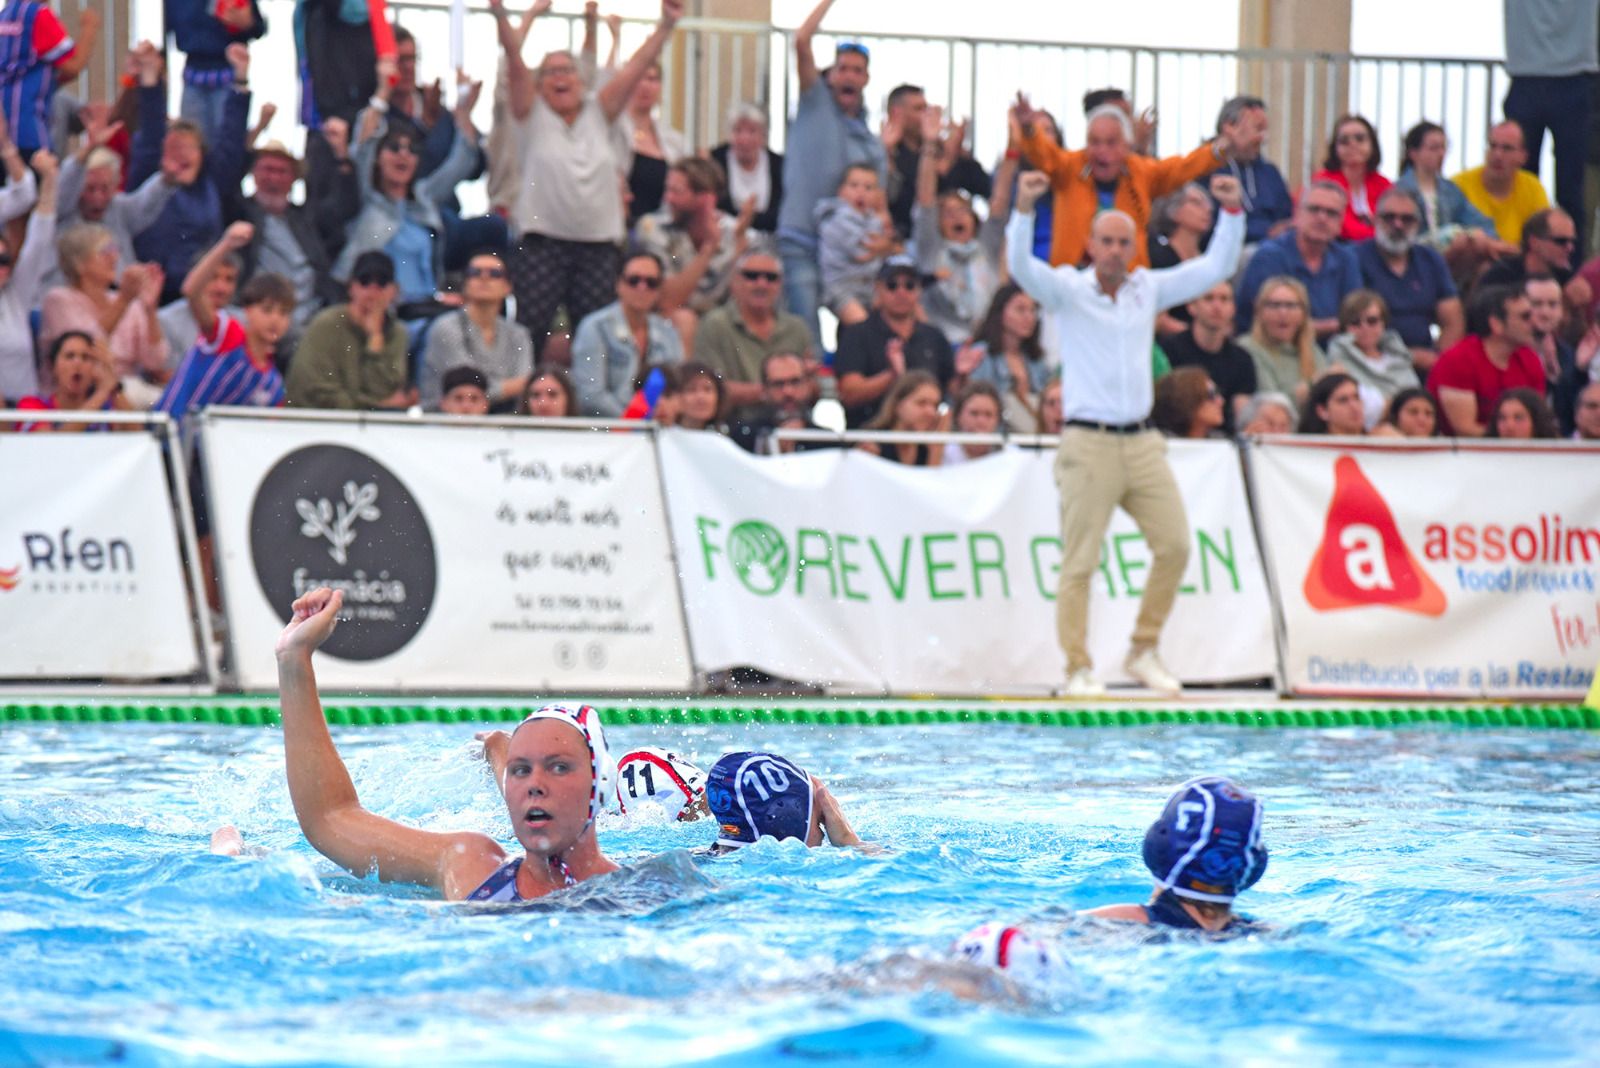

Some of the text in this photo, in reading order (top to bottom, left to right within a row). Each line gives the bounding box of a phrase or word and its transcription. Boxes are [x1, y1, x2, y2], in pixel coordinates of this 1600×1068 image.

[24, 526, 135, 571] Rfen
[1030, 527, 1241, 601] GEN
[1338, 523, 1395, 590] a
[622, 763, 655, 798] 11
[743, 760, 791, 802] 10
